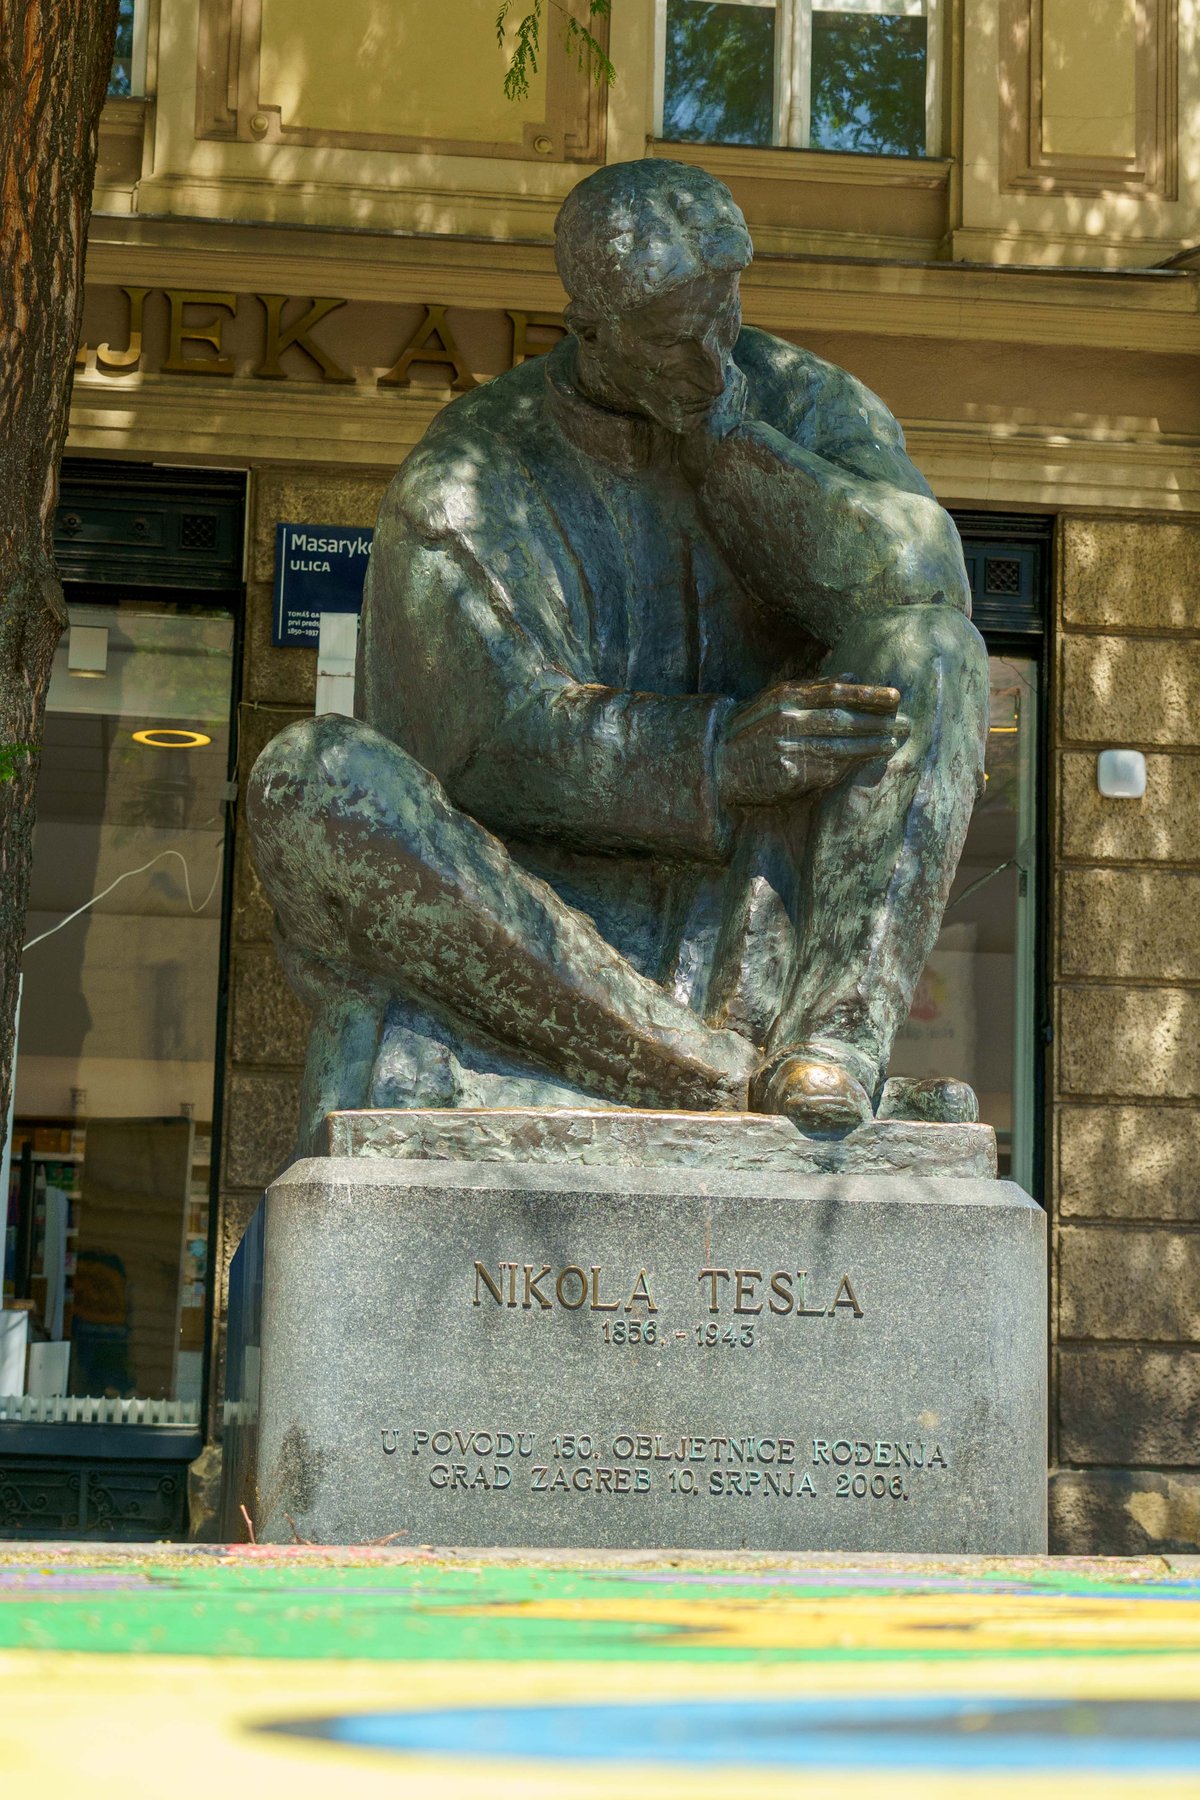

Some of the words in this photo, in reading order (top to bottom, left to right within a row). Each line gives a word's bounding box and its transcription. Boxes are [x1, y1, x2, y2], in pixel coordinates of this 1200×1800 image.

[290, 560, 331, 572] ULICA
[472, 1260, 659, 1314] NIKOLA
[697, 1266, 865, 1319] TESLA
[380, 1428, 400, 1455] U
[411, 1429, 536, 1458] POVODU
[551, 1433, 600, 1460] 150.
[612, 1434, 796, 1465] OBLJETNICE
[812, 1438, 948, 1469] ROĐENJA
[429, 1463, 513, 1491] GRAD
[531, 1465, 652, 1494] ZAGREB
[668, 1468, 699, 1496] 10.
[708, 1470, 818, 1498] SRPNJA
[835, 1473, 909, 1501] 2006.
